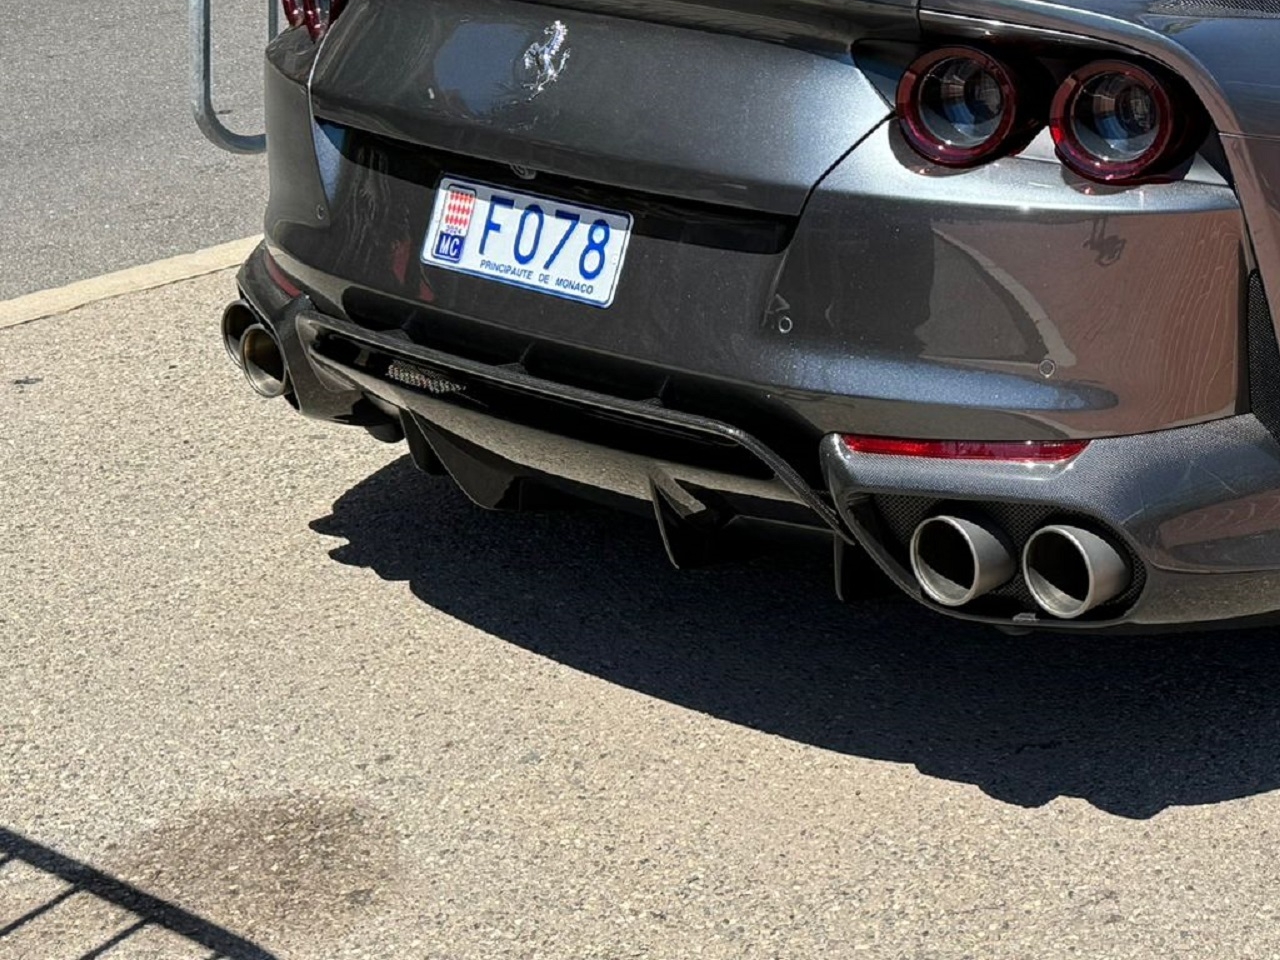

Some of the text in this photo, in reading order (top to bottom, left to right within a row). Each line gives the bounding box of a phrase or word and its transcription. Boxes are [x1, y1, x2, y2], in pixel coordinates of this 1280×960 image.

[438, 234, 460, 257] MC
[478, 195, 611, 281] F078
[479, 258, 594, 296] PRINCIPAUTE DE MONACO
